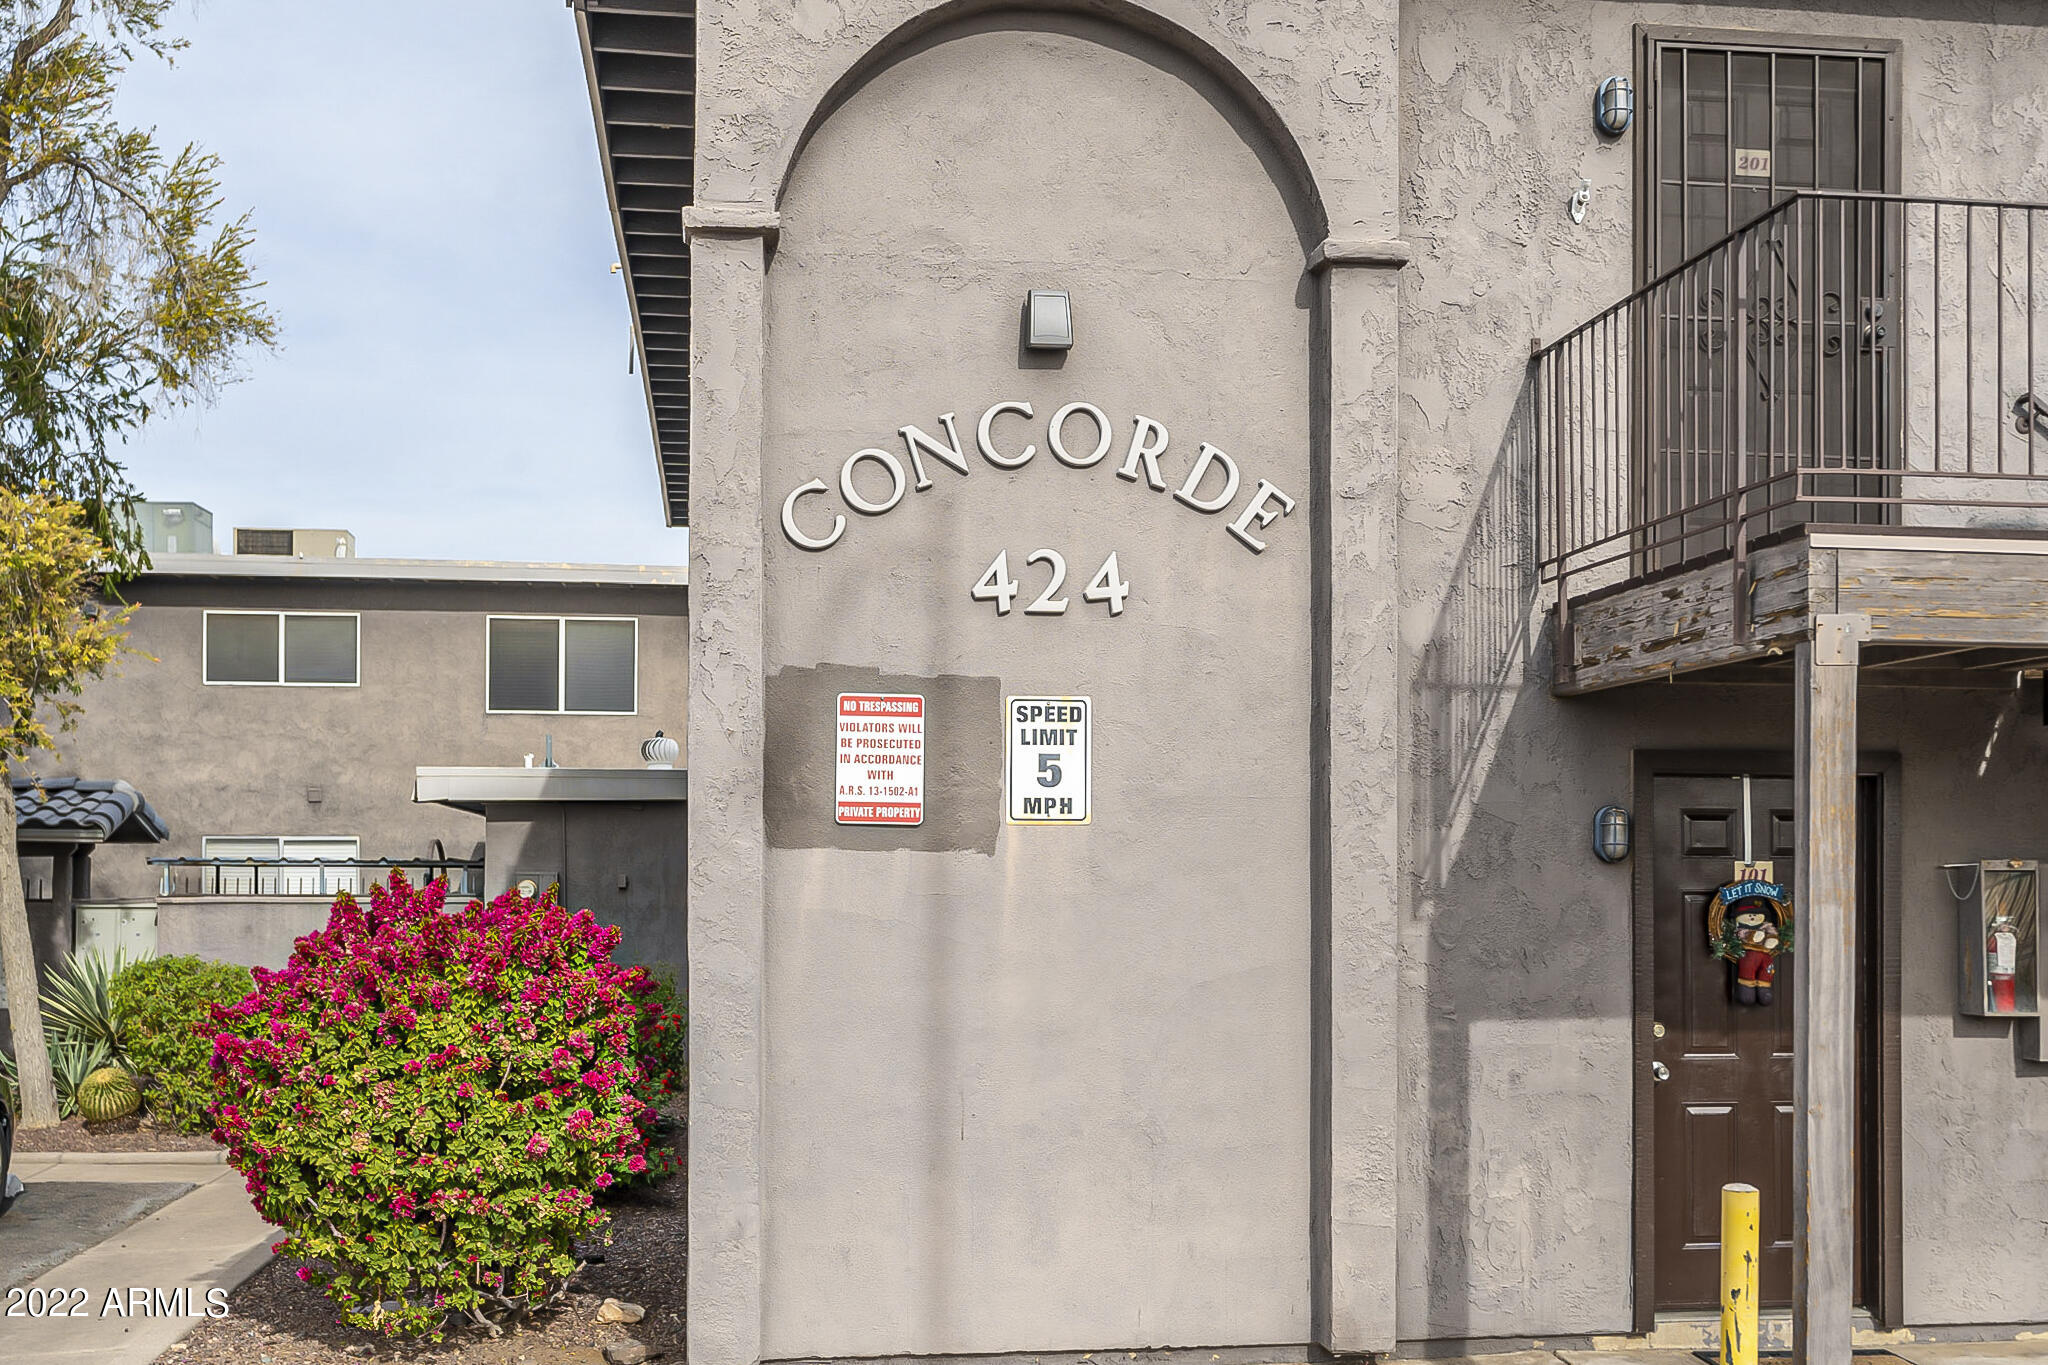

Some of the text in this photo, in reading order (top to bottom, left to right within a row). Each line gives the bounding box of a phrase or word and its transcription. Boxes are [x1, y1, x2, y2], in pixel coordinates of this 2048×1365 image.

[1738, 156, 1769, 171] 201
[781, 401, 1296, 553] CONCORDE
[971, 548, 1130, 617] 424
[843, 700, 919, 713] NO TRESPASSING
[1016, 705, 1082, 722] SPEED
[840, 722, 923, 733] VIOLATORS WILL
[841, 738, 921, 749] BE PROSECUTED
[1021, 729, 1077, 745] LIMIT
[840, 753, 922, 765] IN ACCORDANCE
[867, 770, 894, 780] WITH
[1037, 753, 1062, 788] 5
[839, 785, 918, 796] A.R.S. 13-1502-A1
[838, 806, 920, 818] PRIVATE PROPERTY
[1024, 797, 1072, 814] MPH
[1740, 868, 1767, 881] 101
[1726, 882, 1778, 900] LET IT SNOW
